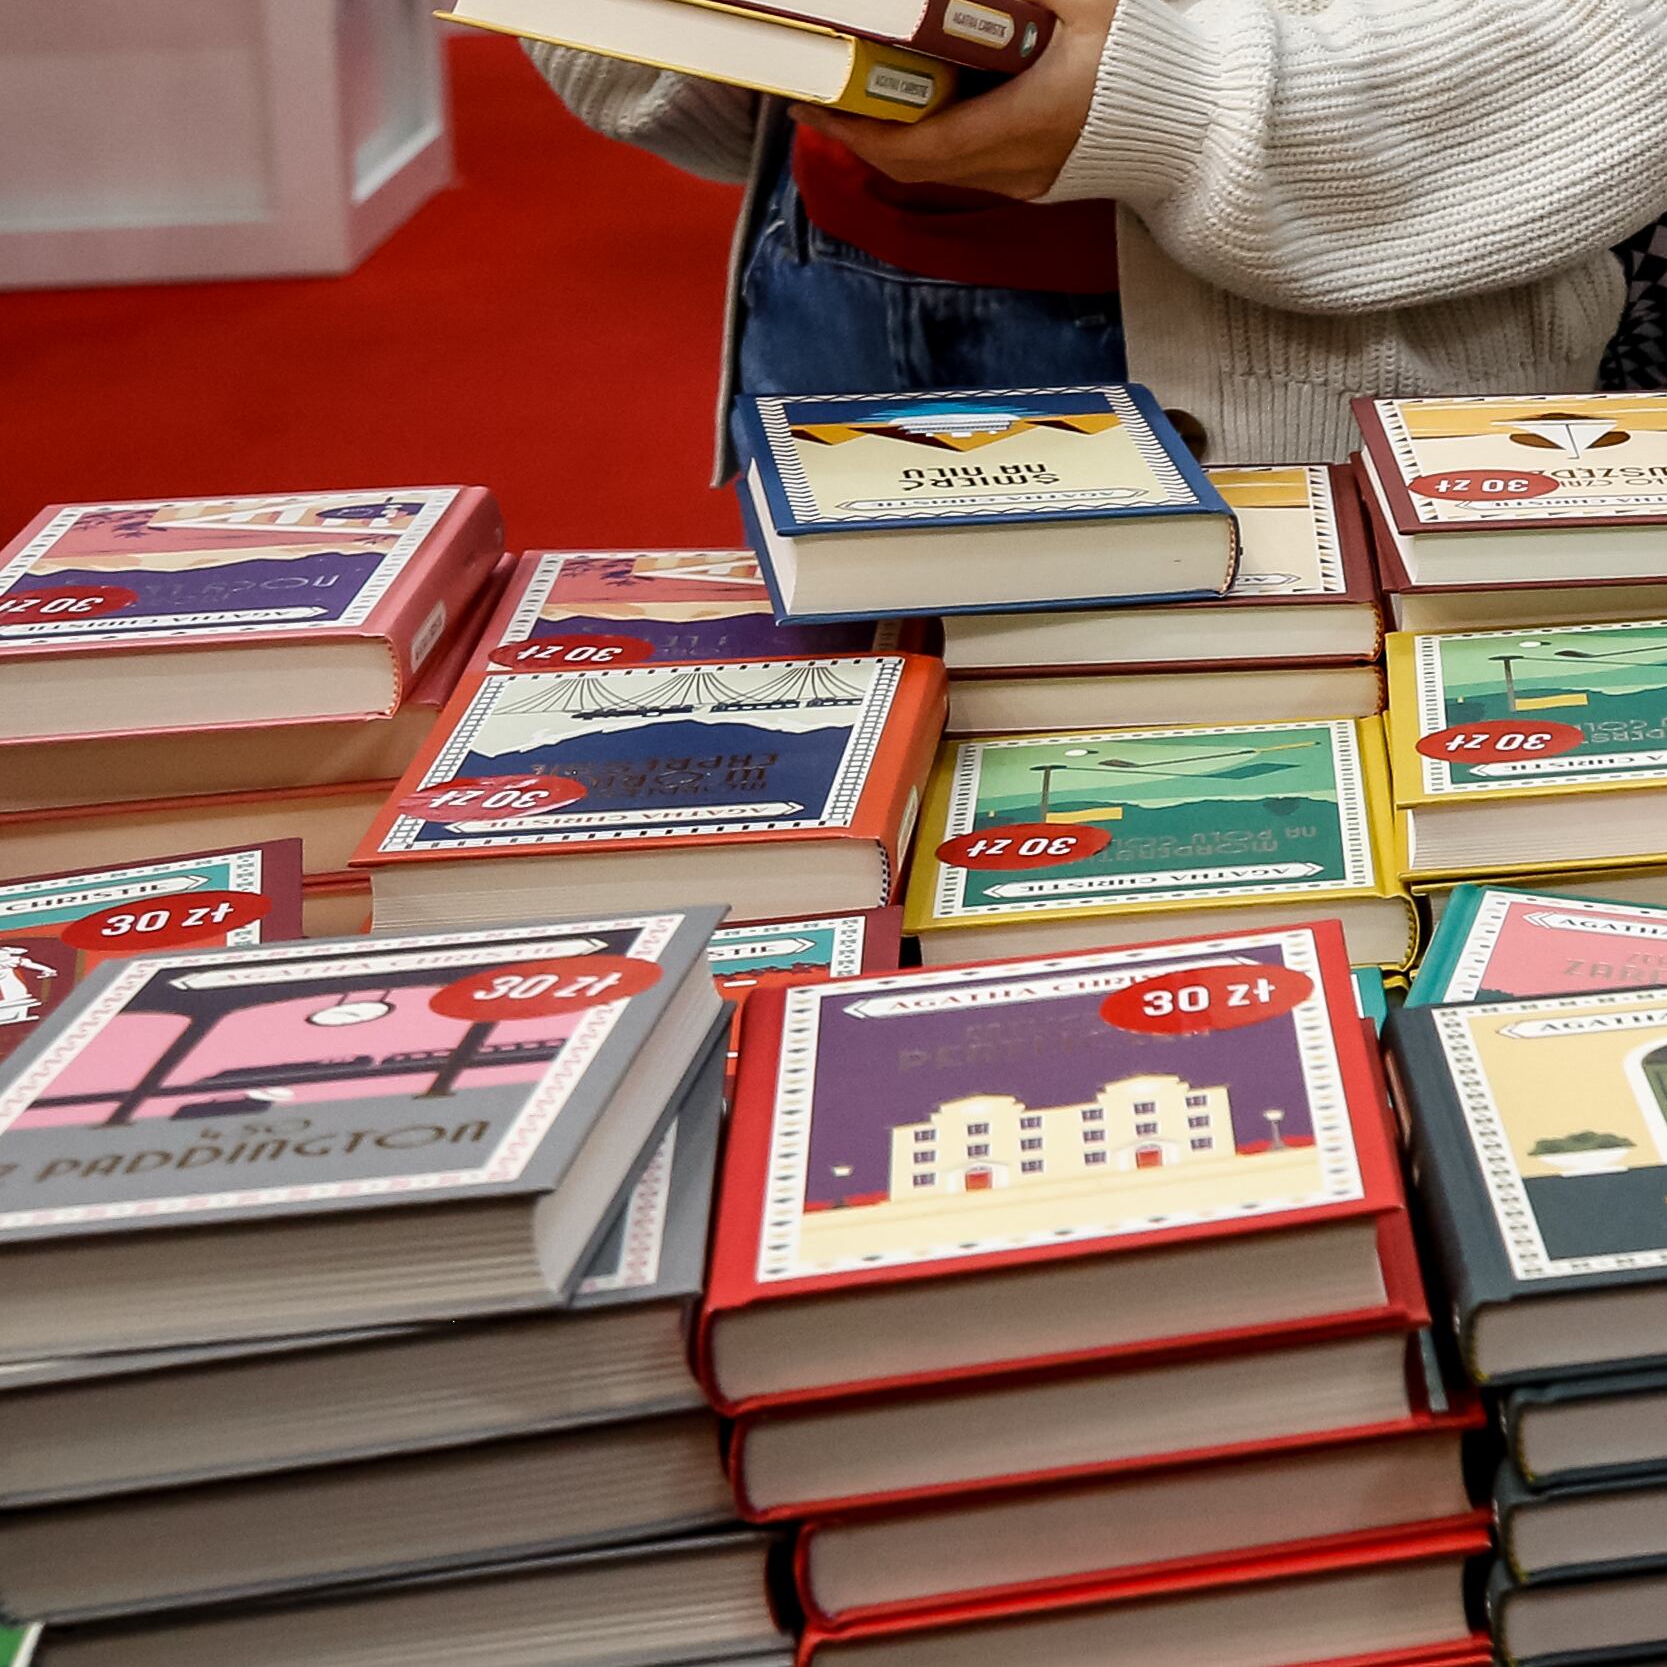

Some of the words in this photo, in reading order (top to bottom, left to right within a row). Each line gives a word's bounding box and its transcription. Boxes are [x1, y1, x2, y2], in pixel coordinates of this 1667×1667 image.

[902, 463, 984, 479] NILU
[1000, 463, 1048, 477] NA
[1434, 478, 1472, 493] zł
[1480, 478, 1530, 493] 30
[876, 495, 992, 510] CHRISTIE
[1006, 489, 1116, 503] AGATHA
[1493, 497, 1608, 509] CHRISTIE
[38, 597, 105, 614] 30
[171, 609, 292, 625] AGATHA
[516, 645, 556, 661] zł
[565, 646, 624, 664] 30
[1445, 733, 1483, 752] zł
[1498, 733, 1553, 752] 30
[1510, 754, 1636, 773] CHRISTIE
[428, 789, 484, 808] zł
[481, 789, 553, 809] 30
[488, 810, 630, 829] CHRISTIE
[629, 805, 770, 822] AGATHA
[965, 836, 1013, 858] zł
[1017, 836, 1078, 857] 30
[1171, 865, 1293, 883] AGATHA
[1019, 875, 1157, 894] CHRISTIE
[4, 881, 168, 913] CHRISTIE
[101, 909, 172, 937] 30
[180, 902, 236, 929] zł
[471, 972, 545, 1002] 30
[555, 968, 624, 998] zł
[890, 985, 1035, 1011] AGATHA
[1141, 988, 1209, 1018] 30
[1225, 978, 1277, 1007] zł
[33, 1118, 492, 1184] PADDINGTON
